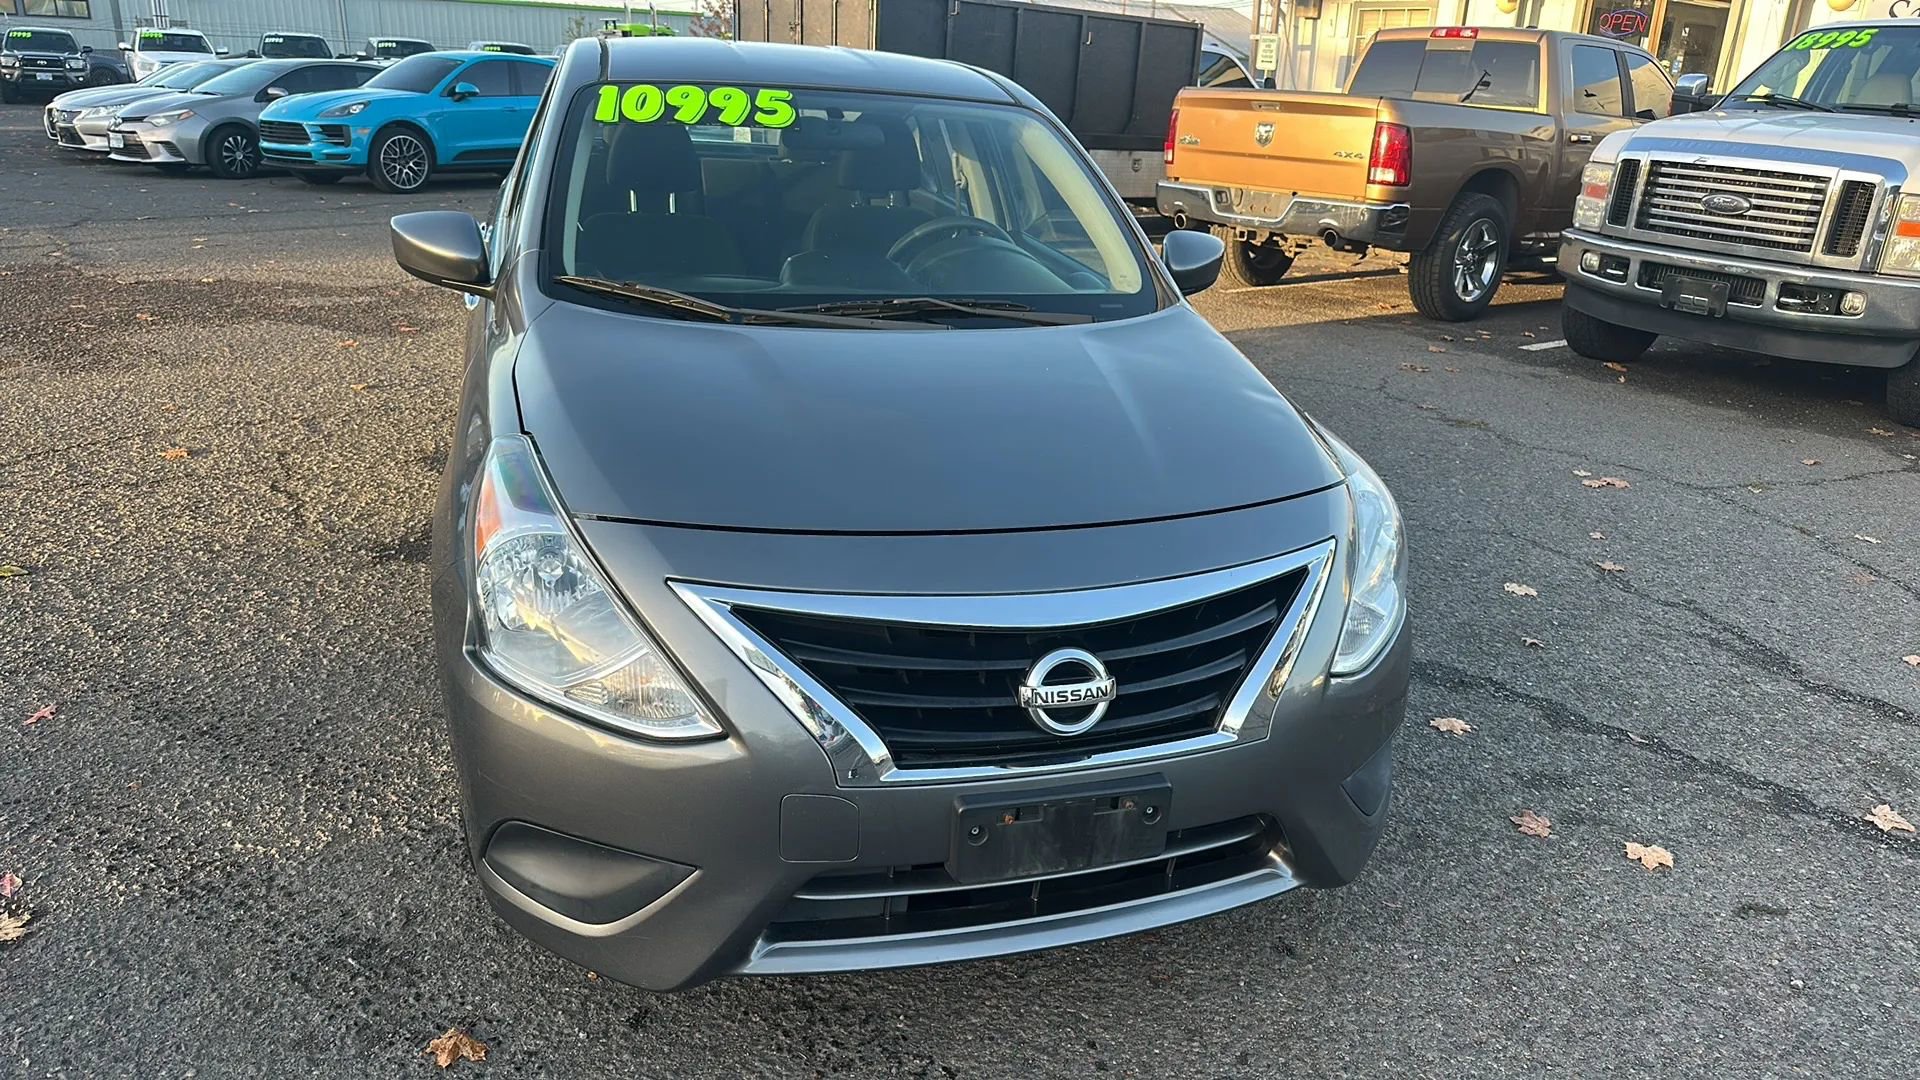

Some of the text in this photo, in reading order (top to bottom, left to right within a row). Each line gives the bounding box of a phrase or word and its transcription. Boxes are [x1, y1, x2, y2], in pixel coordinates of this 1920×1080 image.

[1600, 13, 1649, 33] OPEN
[1784, 28, 1880, 52] 18995
[595, 83, 797, 129] 10995
[1035, 685, 1109, 704] NISSAN
